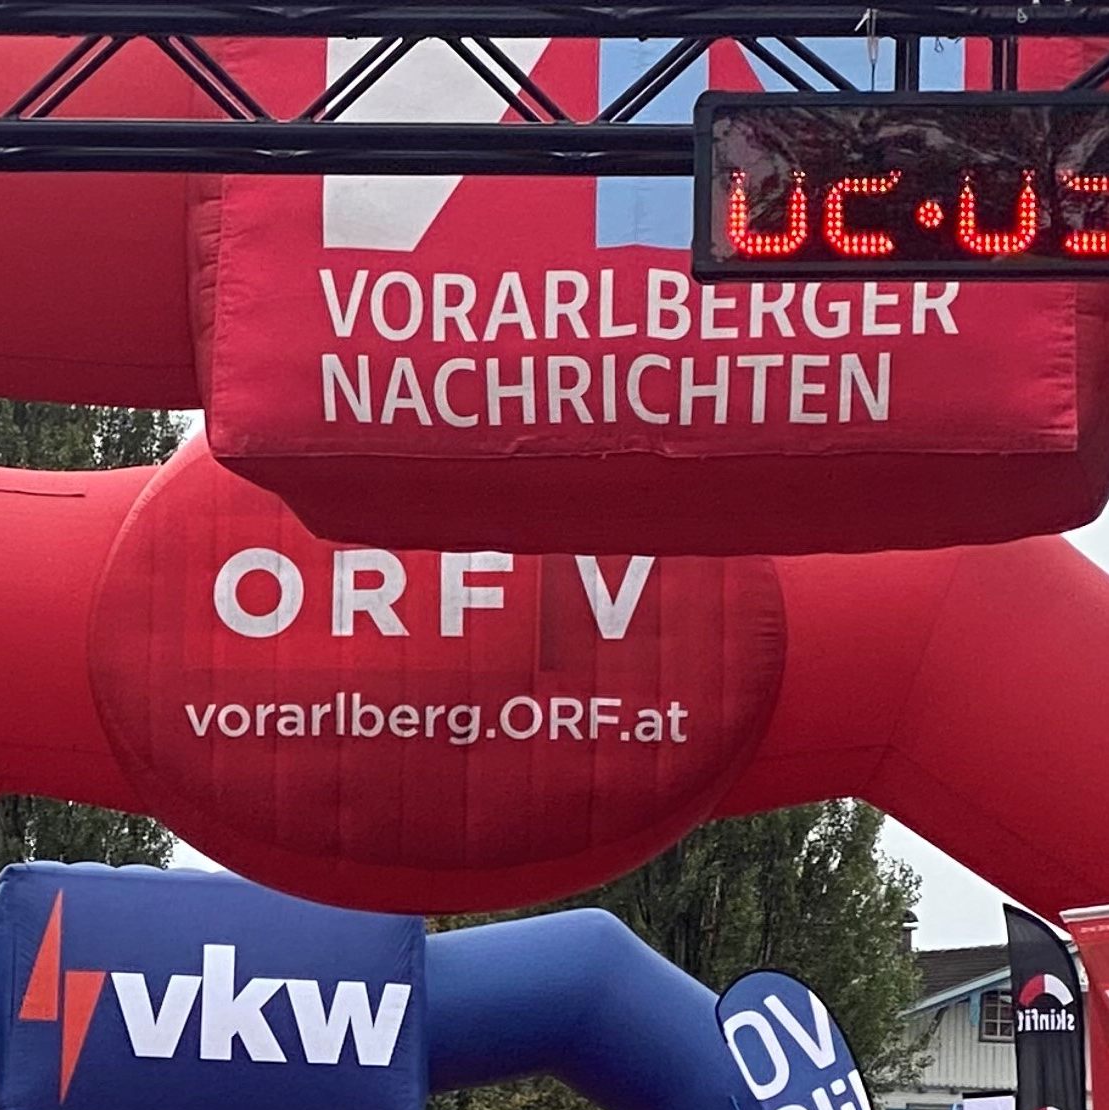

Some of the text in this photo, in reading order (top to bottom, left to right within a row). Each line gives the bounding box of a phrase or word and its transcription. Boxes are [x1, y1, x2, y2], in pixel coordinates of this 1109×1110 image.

[320, 268, 960, 341] VORARLBERGER
[322, 352, 892, 426] NACHRICHTEN
[212, 546, 655, 640] ORF V
[185, 691, 688, 746] vorarlberg.ORF.at
[111, 944, 412, 1067] vkw
